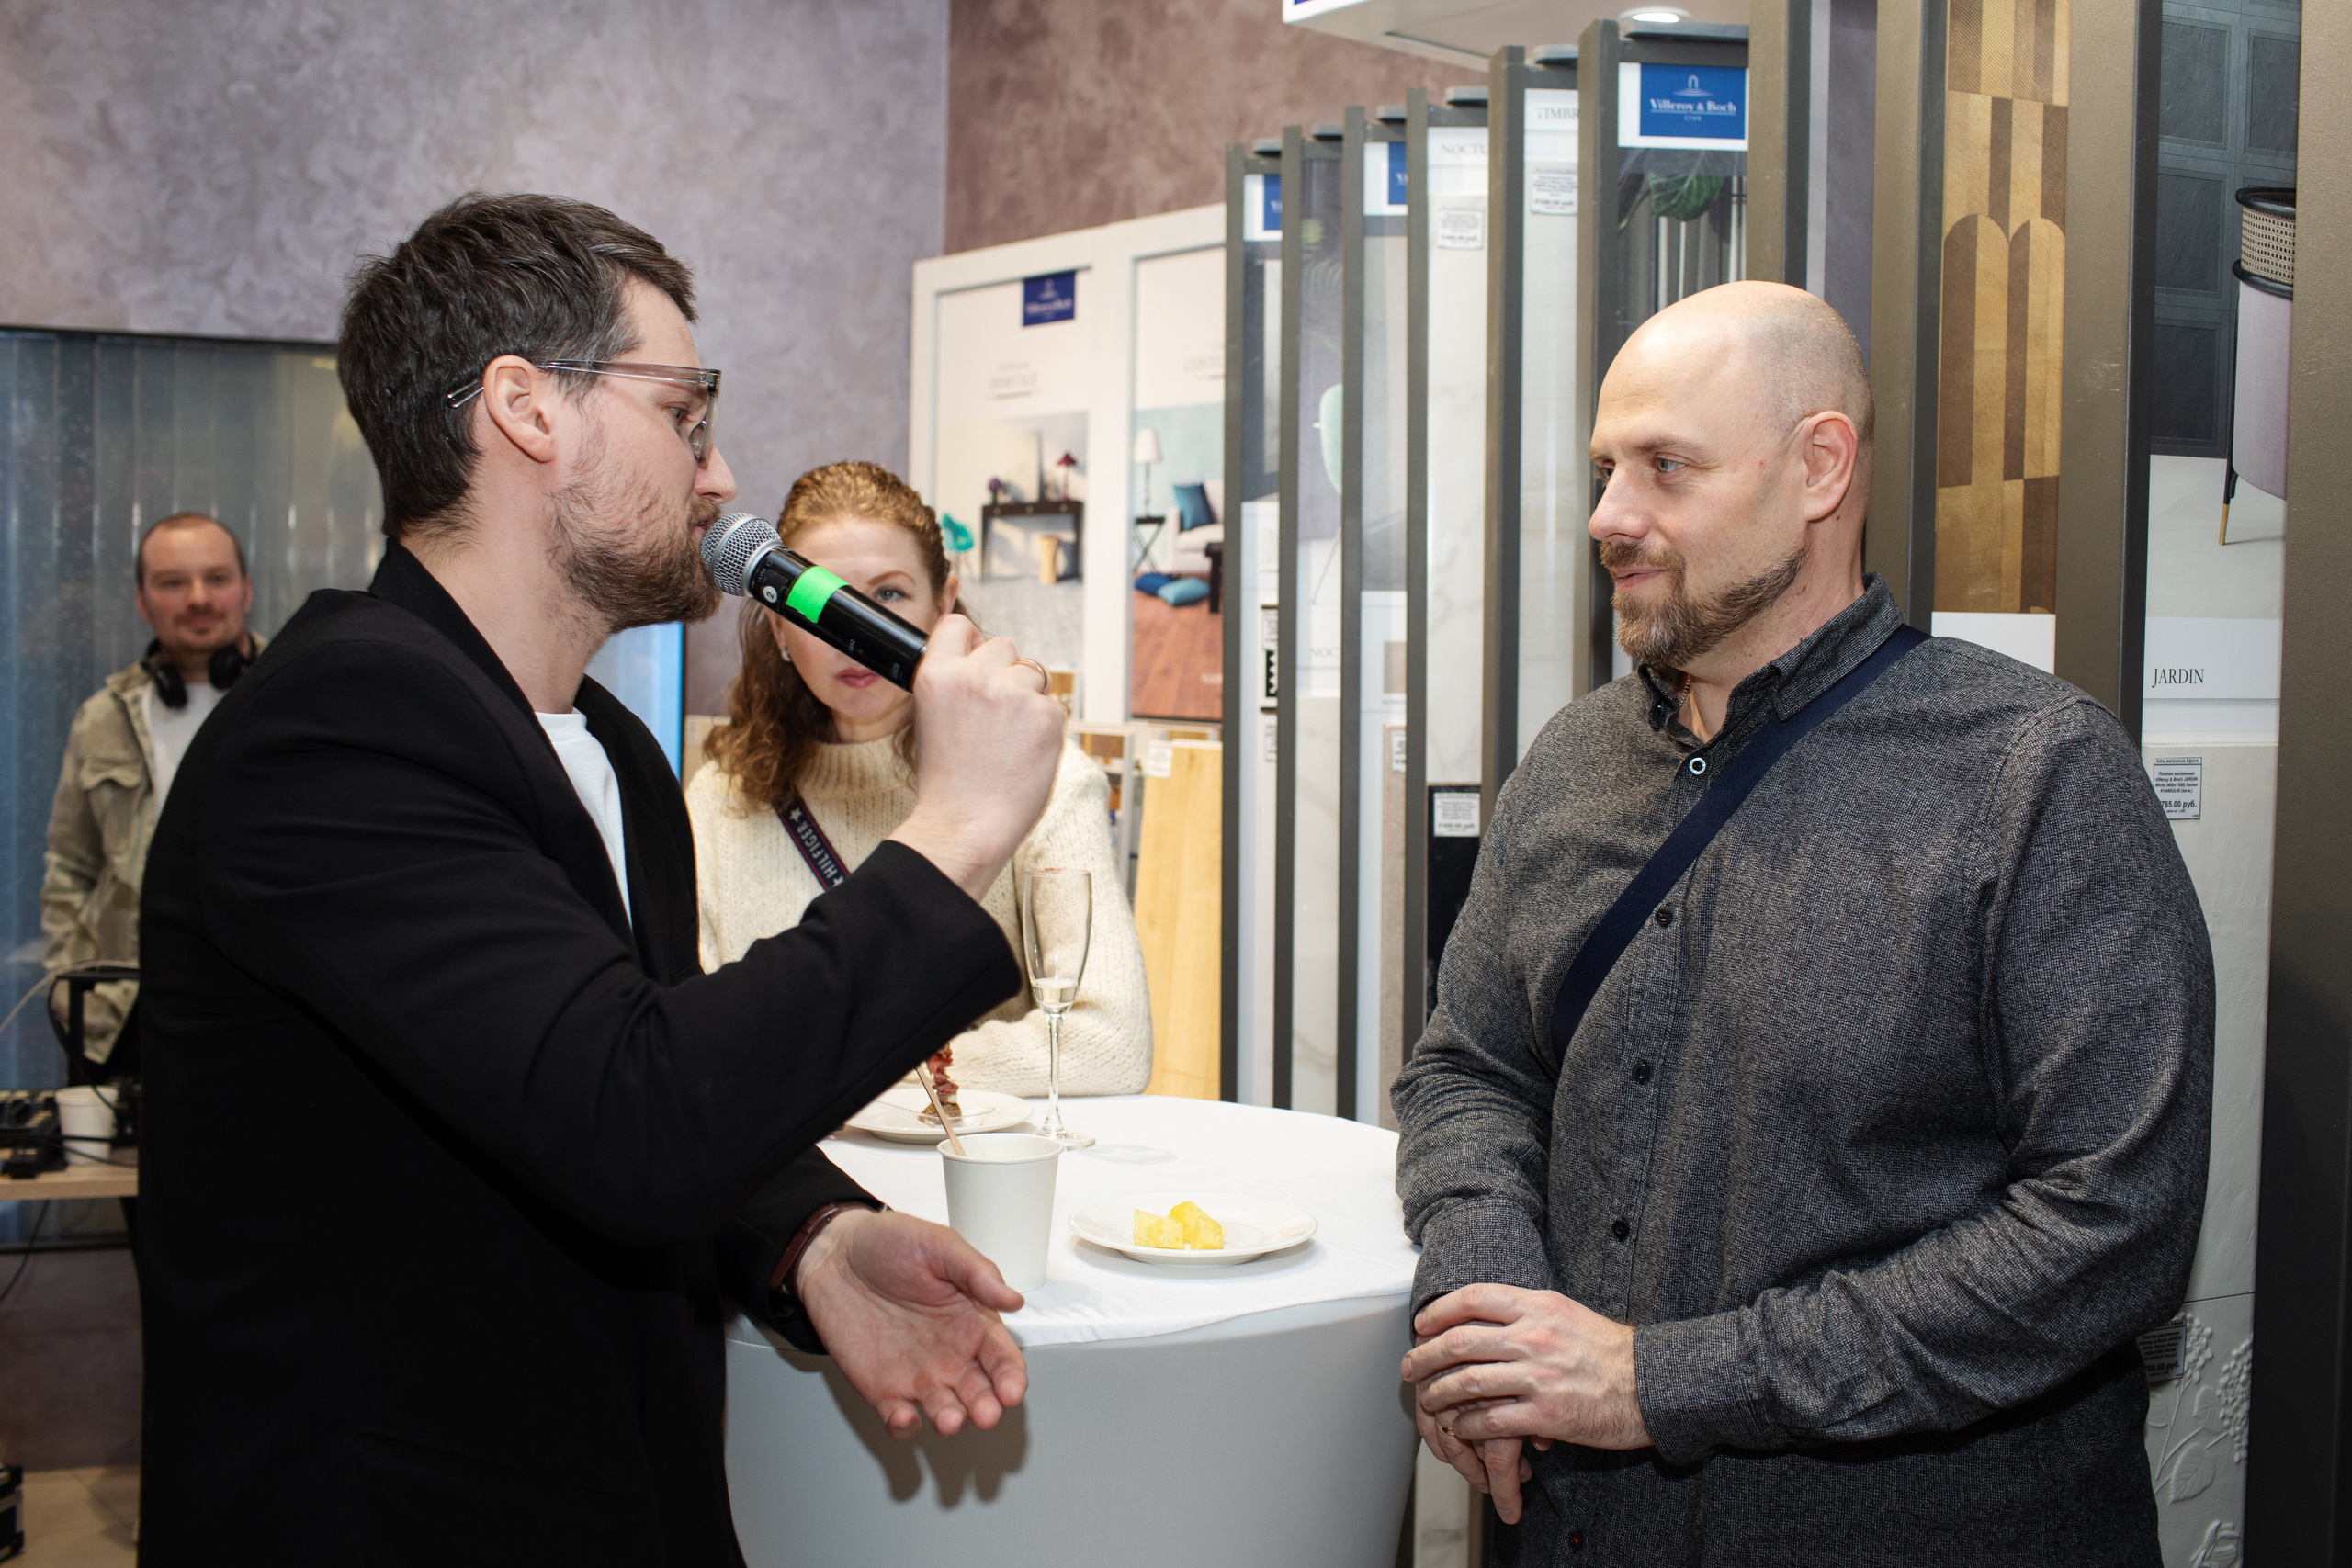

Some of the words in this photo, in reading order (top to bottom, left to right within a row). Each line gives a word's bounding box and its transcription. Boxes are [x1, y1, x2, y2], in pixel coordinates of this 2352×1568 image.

[1649, 97, 1693, 111] Villeroy
[1696, 101, 1705, 111] &
[1706, 100, 1736, 113] Boch
[766, 591, 775, 600] 2
[2151, 668, 2205, 689] JARDIN
[2183, 799, 2197, 809] руб.
[797, 821, 837, 878] HILFIGER
[2166, 1361, 2180, 1370] руб.
